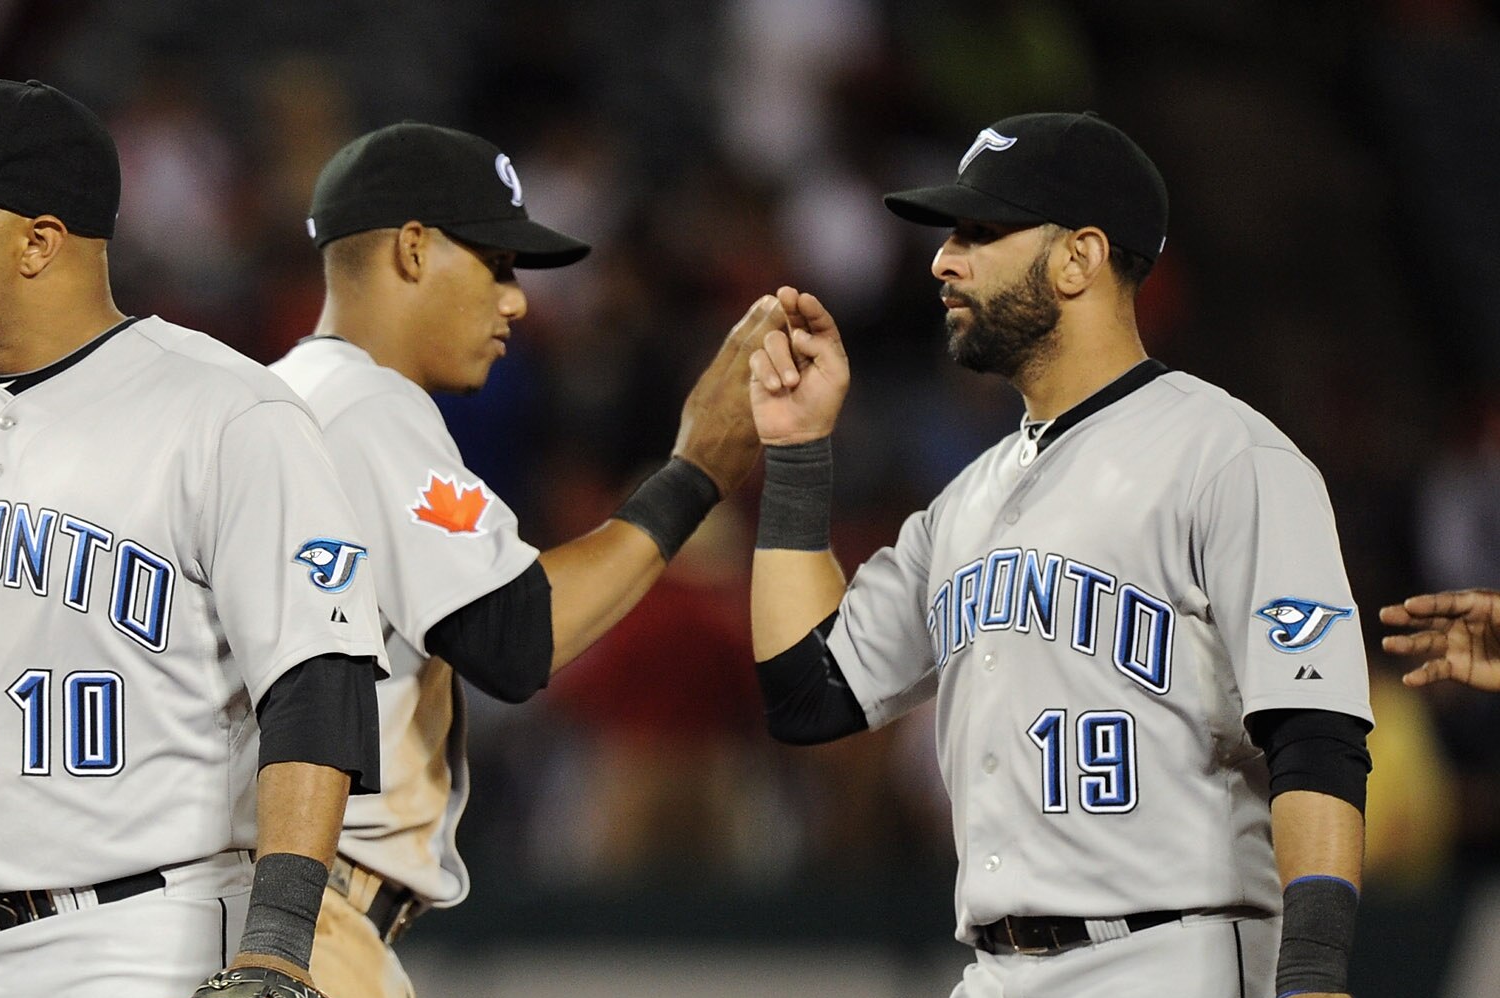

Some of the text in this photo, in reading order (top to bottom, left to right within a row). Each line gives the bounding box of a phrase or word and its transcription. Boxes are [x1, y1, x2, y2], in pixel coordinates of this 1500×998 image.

[927, 547, 1174, 695] ORONTO
[5, 668, 125, 777] 10
[1026, 708, 1138, 814] 19
